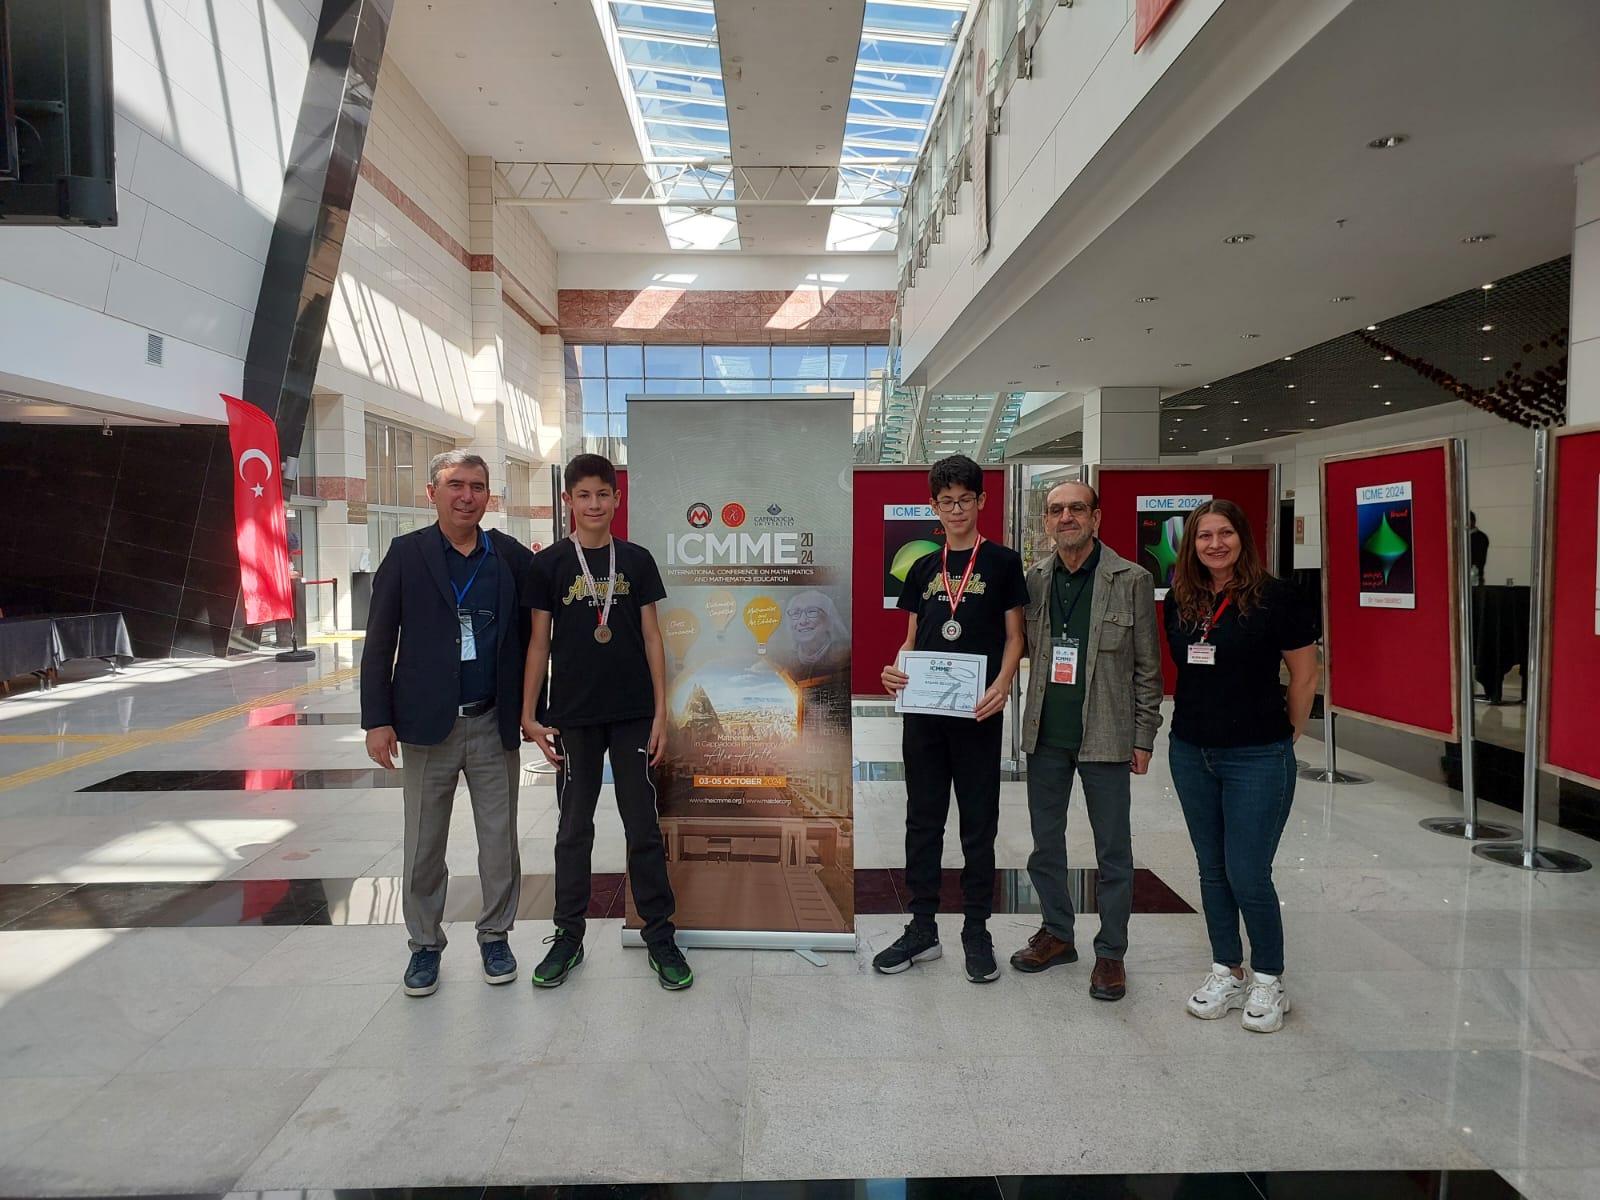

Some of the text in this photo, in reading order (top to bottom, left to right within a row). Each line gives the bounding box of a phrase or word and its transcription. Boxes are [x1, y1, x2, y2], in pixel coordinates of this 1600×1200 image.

[1362, 485, 1405, 500] ICME 2024
[1145, 498, 1174, 509] ICME
[892, 506, 921, 517] ICME
[666, 532, 814, 565] ICMME 20
[801, 550, 814, 565] 24
[698, 777, 782, 787] 03-05 OCTOBER 2024
